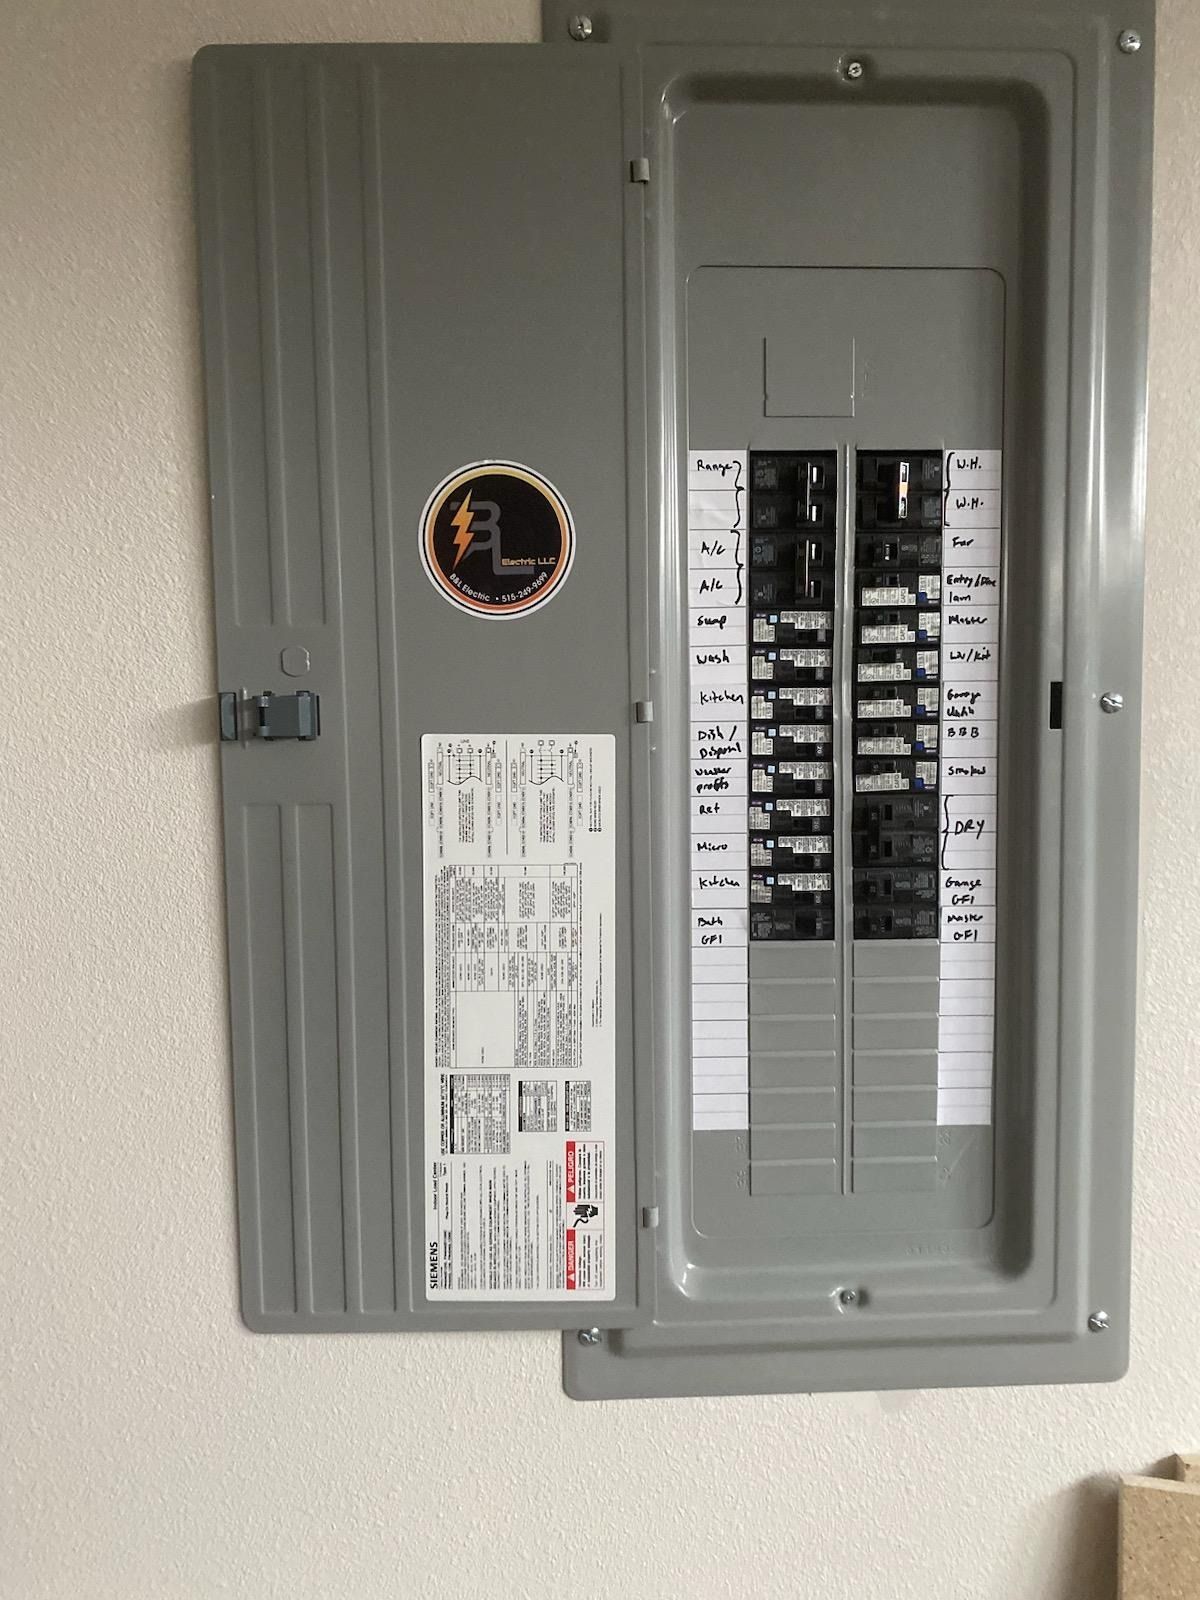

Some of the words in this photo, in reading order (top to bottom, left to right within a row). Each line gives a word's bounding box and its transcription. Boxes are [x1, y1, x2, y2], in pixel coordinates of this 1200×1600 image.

[697, 459, 733, 477] Range
[701, 540, 726, 556] A/C
[501, 558, 536, 566] Electric
[537, 557, 556, 565] LLC
[461, 585, 491, 602] Electric
[699, 578, 723, 594] A/C
[700, 690, 744, 706] Kitchen
[955, 819, 985, 839] DRY
[697, 842, 728, 851] Micro
[699, 876, 740, 889] Kitchen
[952, 895, 974, 905] GFI
[701, 934, 722, 945] GFI
[430, 1242, 438, 1289] SIEMENS
